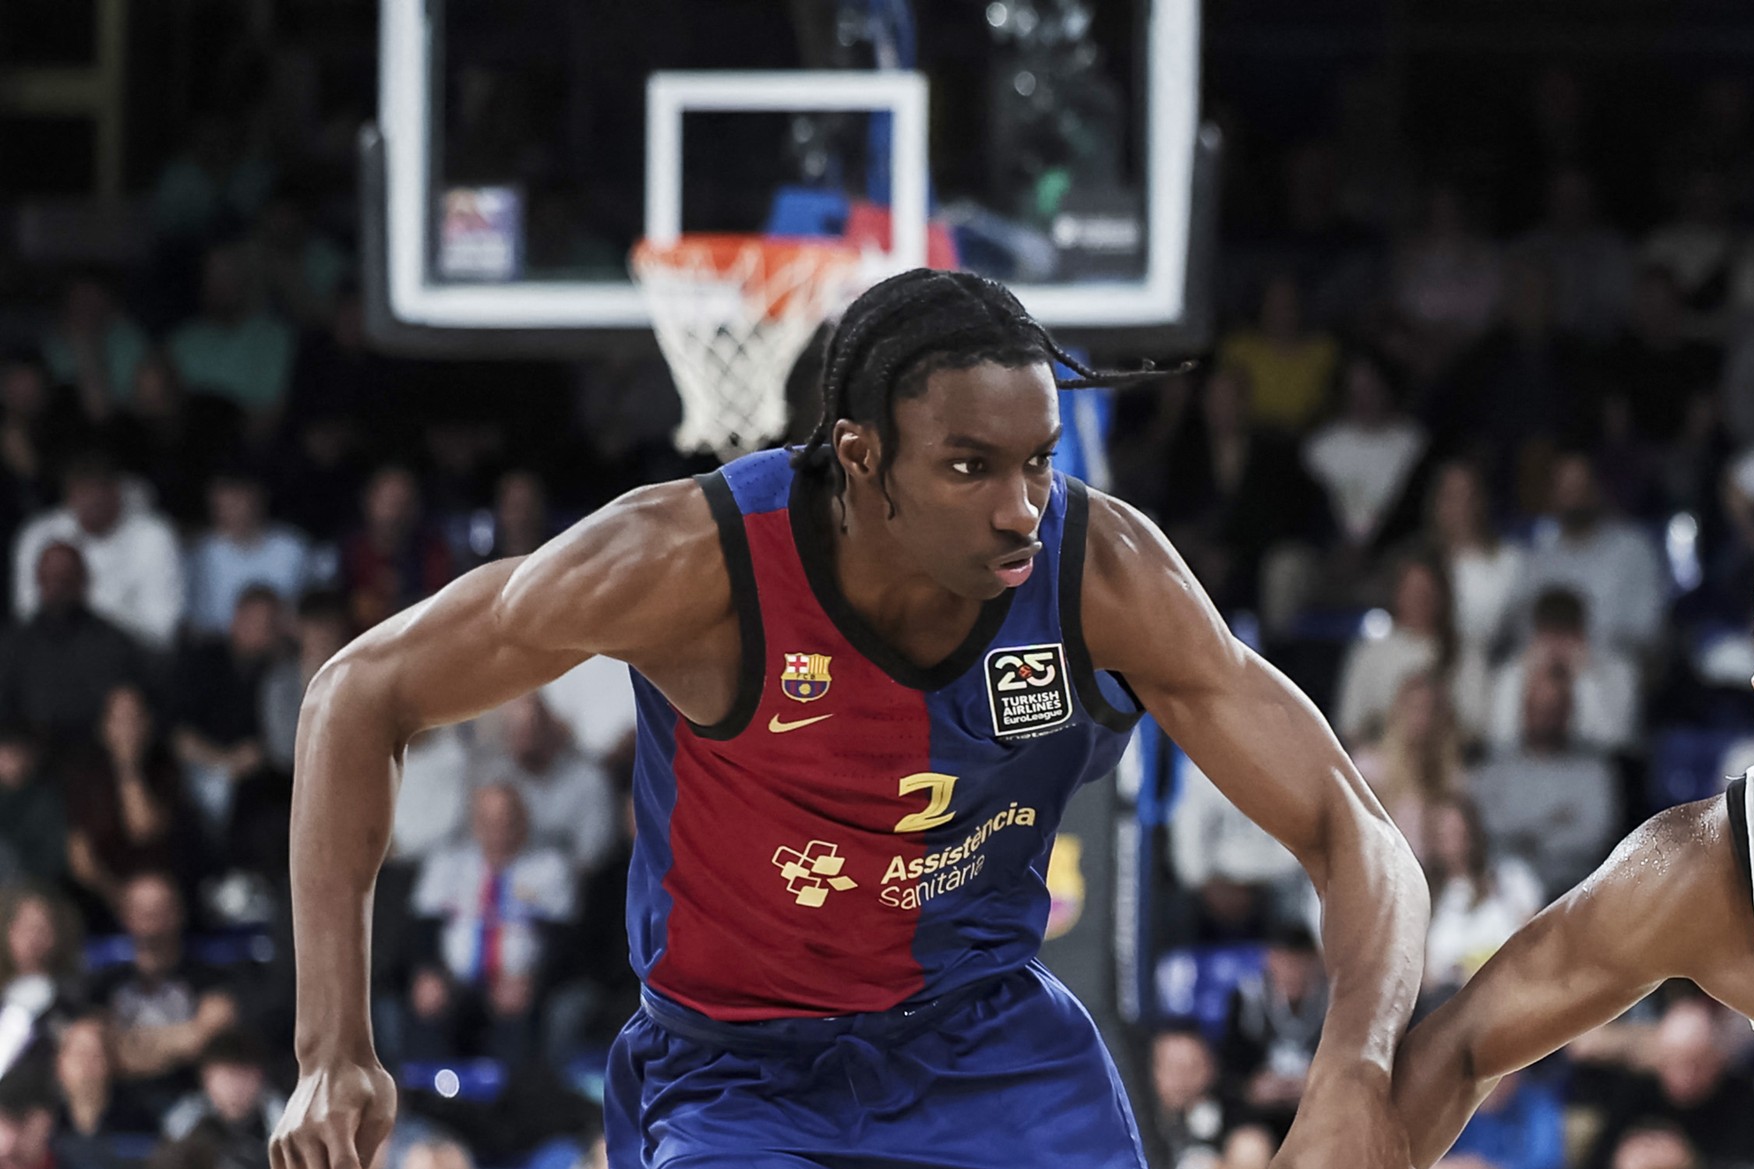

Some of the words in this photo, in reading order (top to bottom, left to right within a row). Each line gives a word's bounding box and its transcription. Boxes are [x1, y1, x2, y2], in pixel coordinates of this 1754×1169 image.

[995, 651, 1056, 691] 25
[1001, 690, 1059, 707] TURKISH
[1003, 699, 1062, 717] AIRLINES
[1003, 708, 1063, 725] EuroLeague
[893, 772, 959, 833] 2
[880, 802, 1036, 884] Assistència
[878, 854, 985, 910] Sanitària
